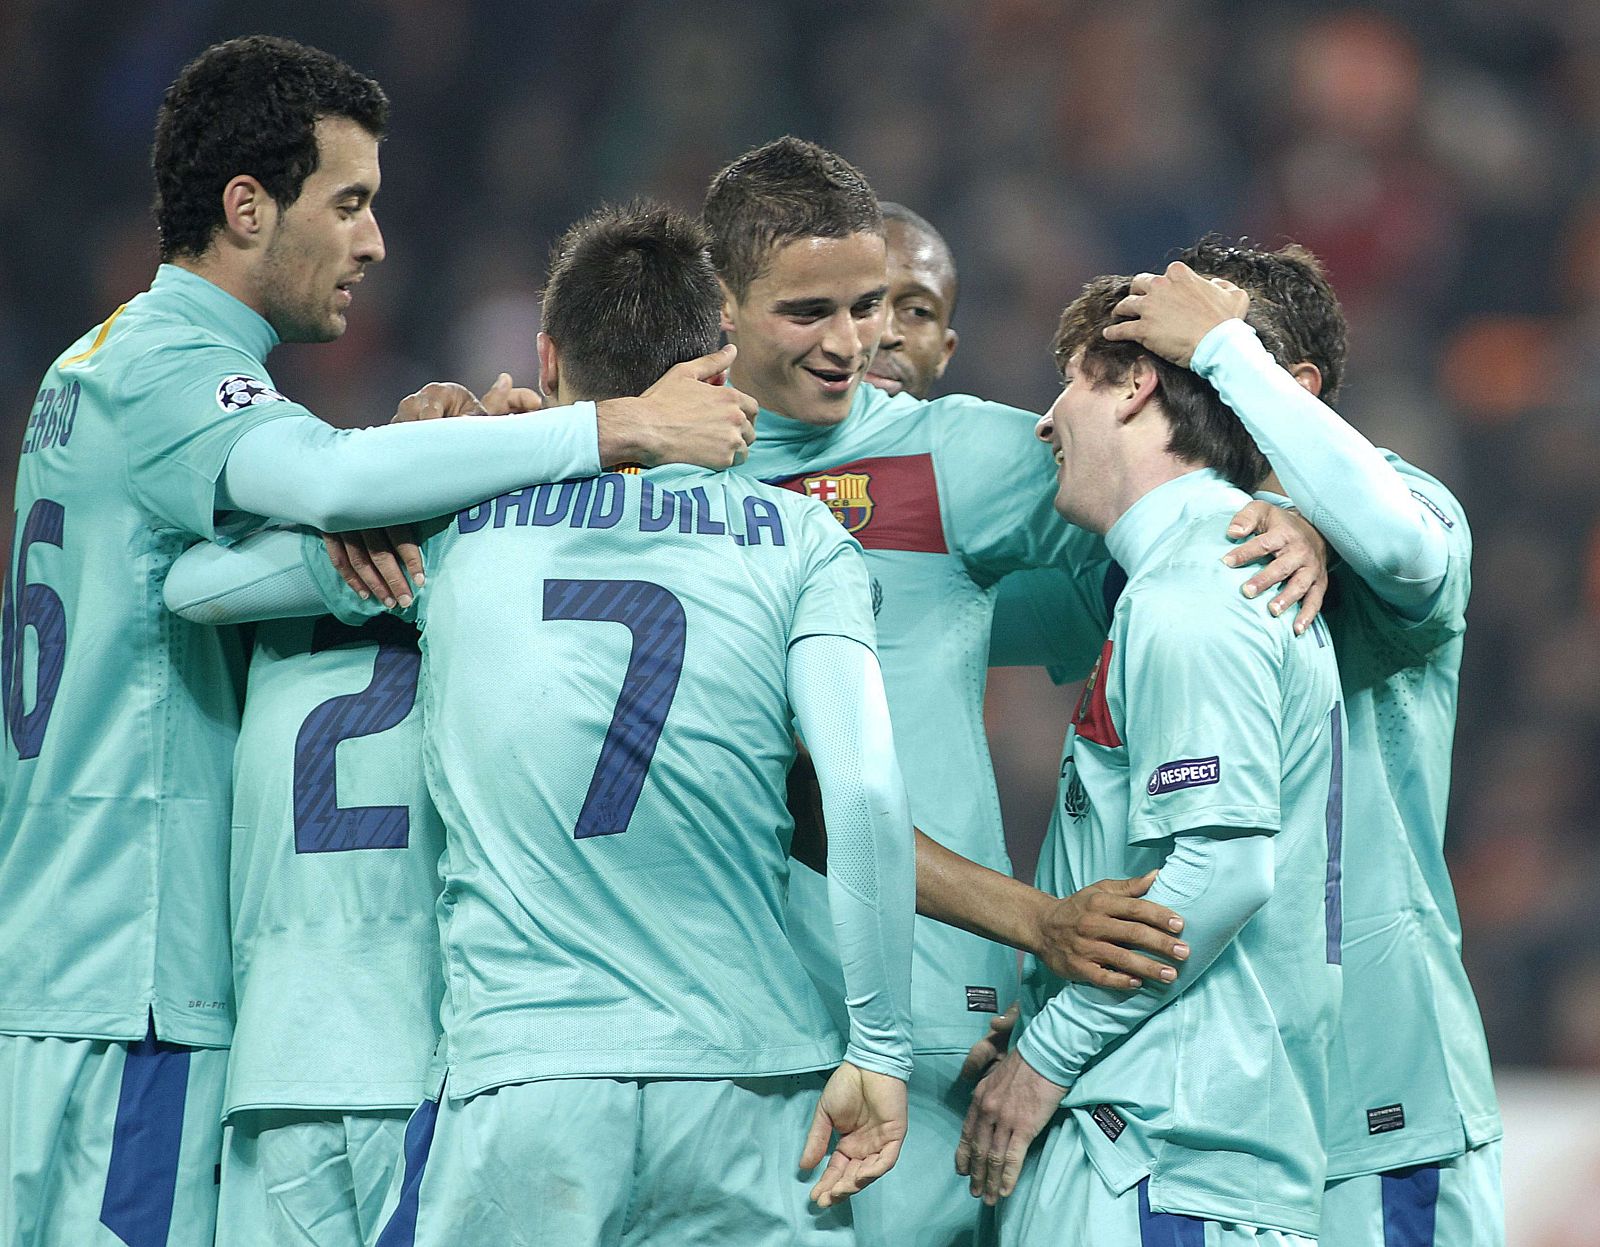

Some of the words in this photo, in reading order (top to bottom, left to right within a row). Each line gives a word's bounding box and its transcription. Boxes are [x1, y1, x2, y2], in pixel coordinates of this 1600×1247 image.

[639, 477, 786, 546] VILA
[293, 613, 422, 854] 2
[543, 579, 687, 839] 7
[1161, 763, 1218, 786] RESPECT
[188, 1000, 226, 1009] DRI-FIT
